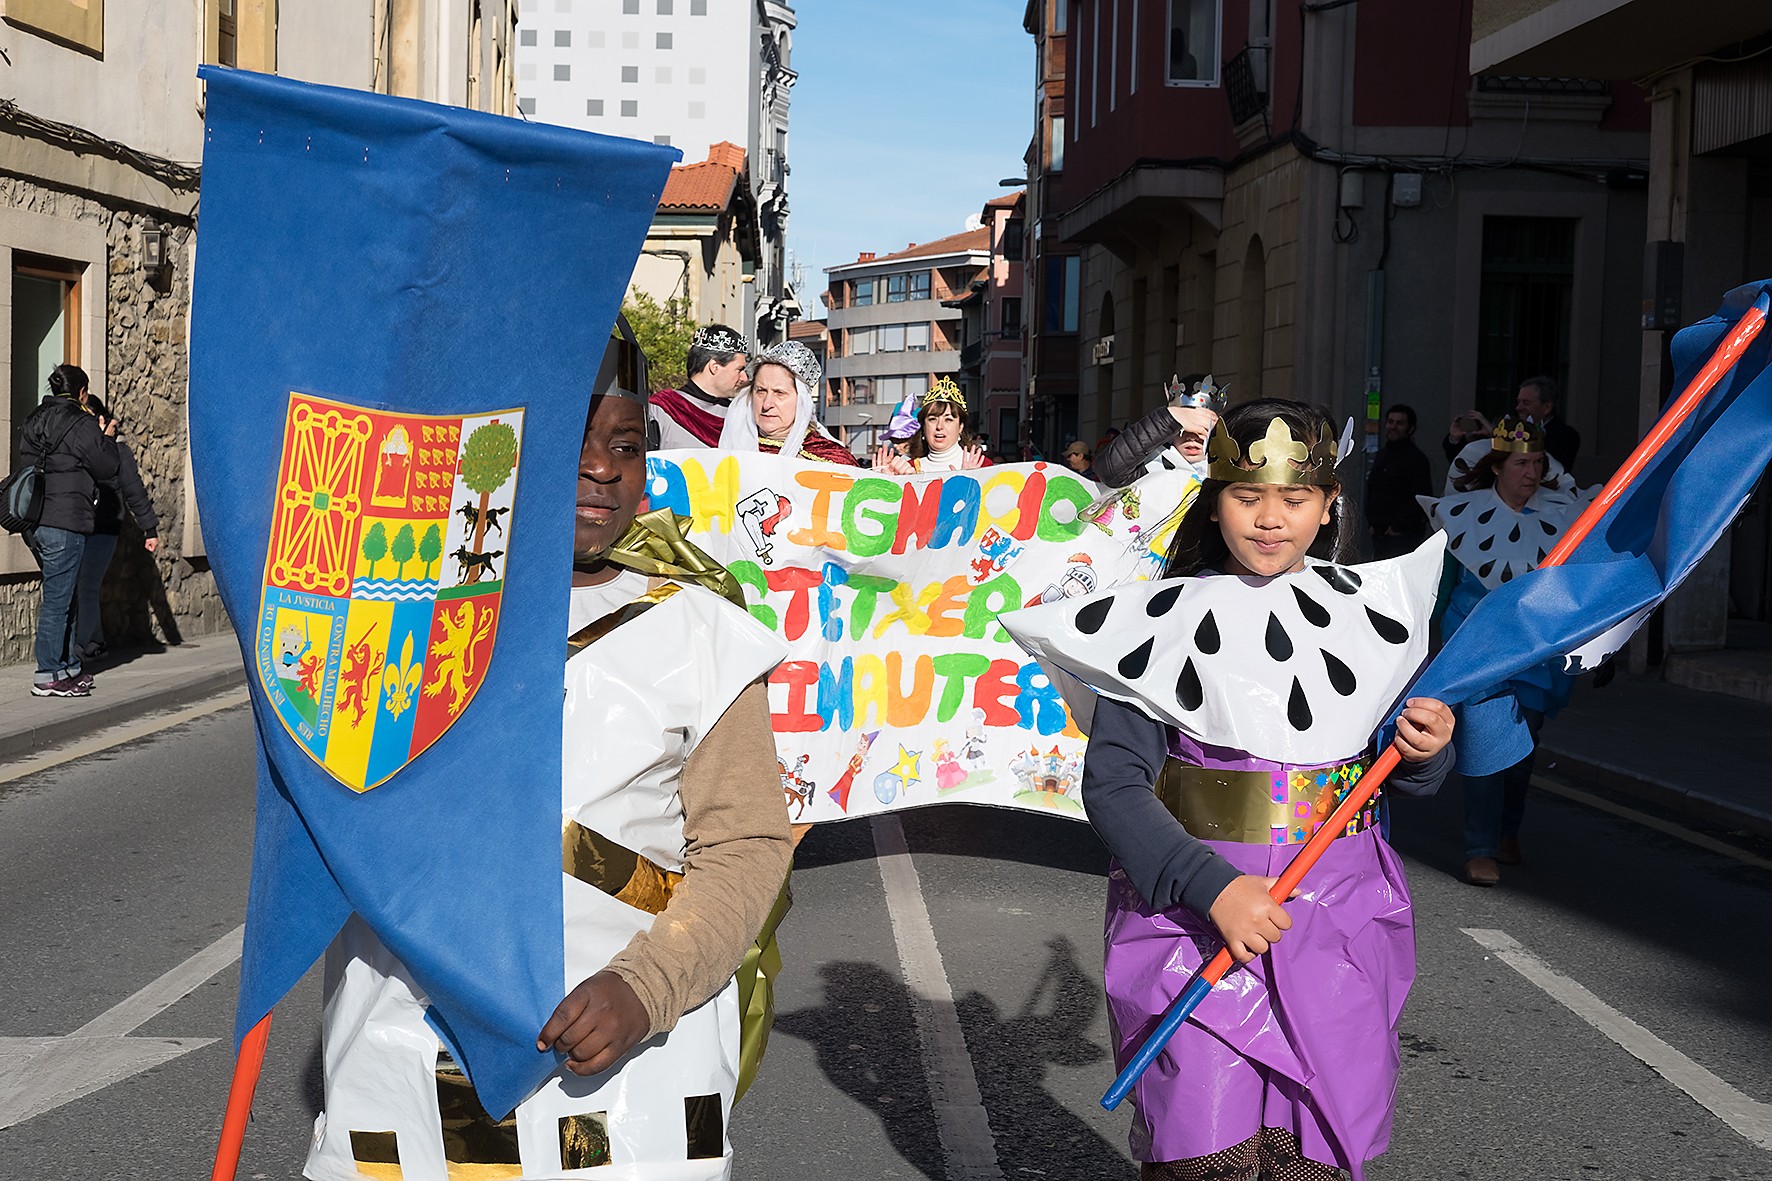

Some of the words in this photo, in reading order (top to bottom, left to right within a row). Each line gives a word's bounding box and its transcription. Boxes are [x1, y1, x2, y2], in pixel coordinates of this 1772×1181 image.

[641, 455, 740, 535] AN
[786, 461, 1096, 557] IGNACIO
[265, 603, 275, 621] DE
[279, 592, 292, 604] LA
[726, 560, 1024, 643] STETXEA
[329, 615, 345, 665] CONTRA
[272, 689, 286, 706] EN
[767, 651, 1090, 739] INAUTER
